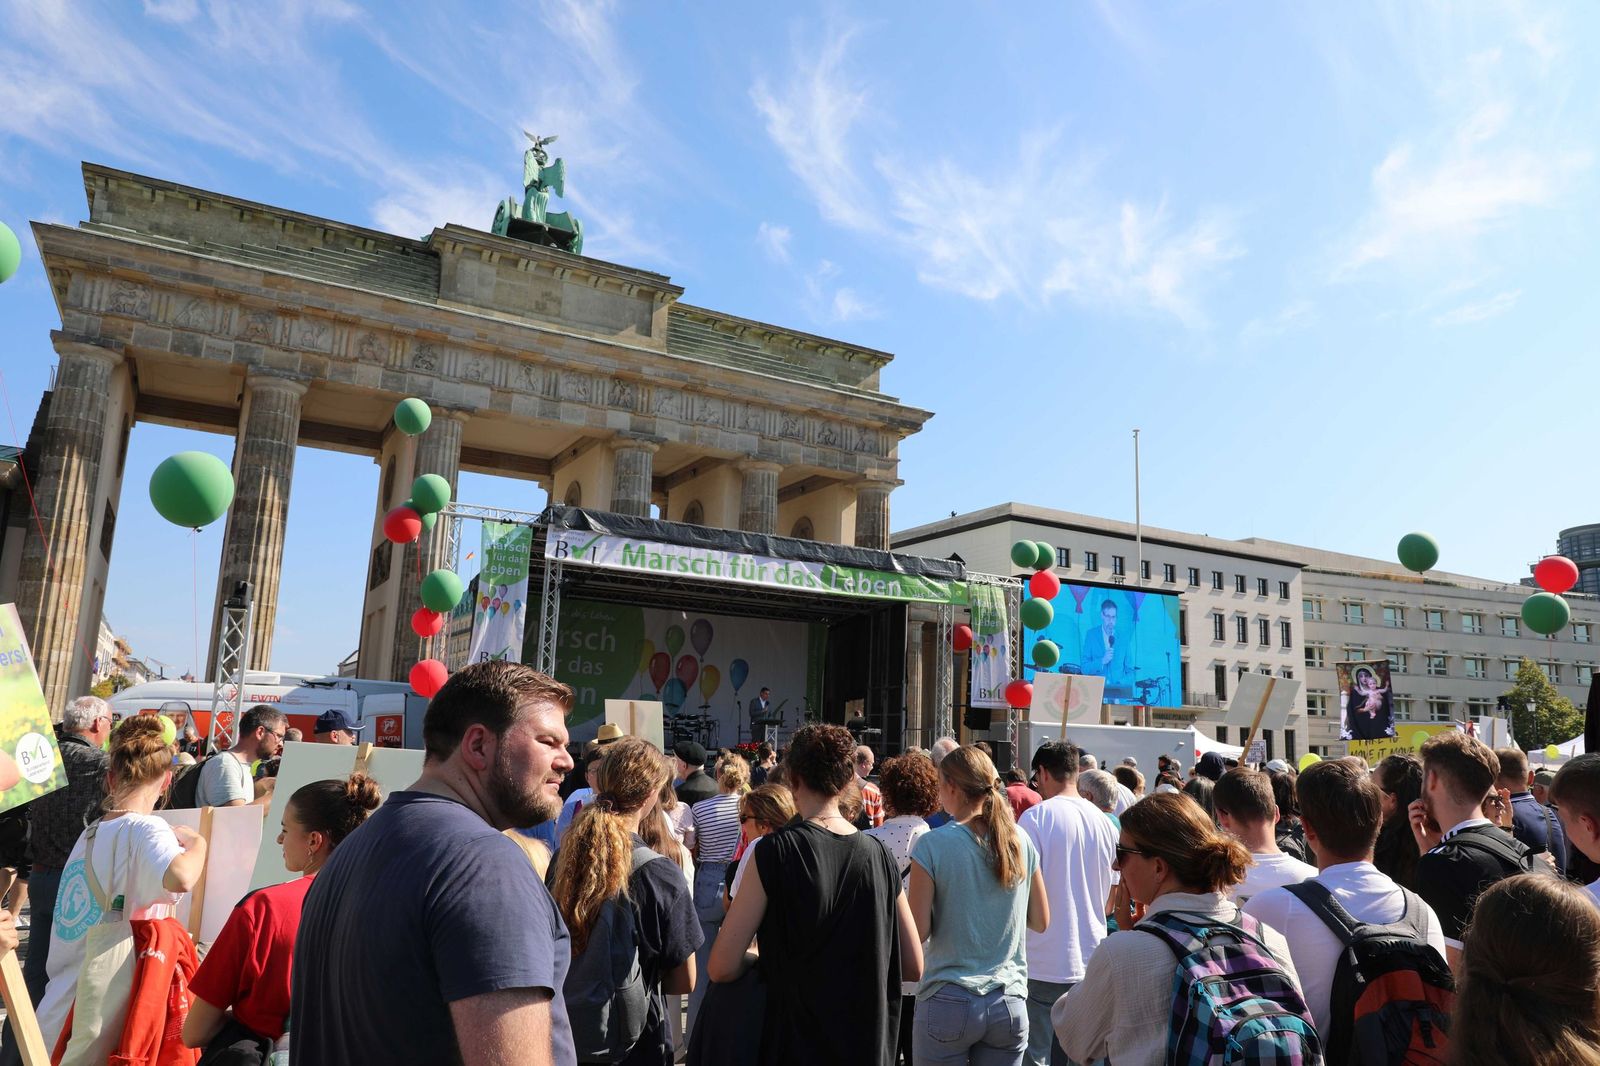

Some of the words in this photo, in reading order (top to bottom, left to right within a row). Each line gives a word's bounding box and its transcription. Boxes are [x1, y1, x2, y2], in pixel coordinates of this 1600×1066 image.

[622, 543, 722, 577] Marsch
[730, 556, 770, 581] für
[774, 562, 817, 588] das
[831, 571, 901, 598] Leben
[567, 656, 604, 676] das
[250, 694, 282, 703] EWTN
[377, 735, 401, 743] EWTN
